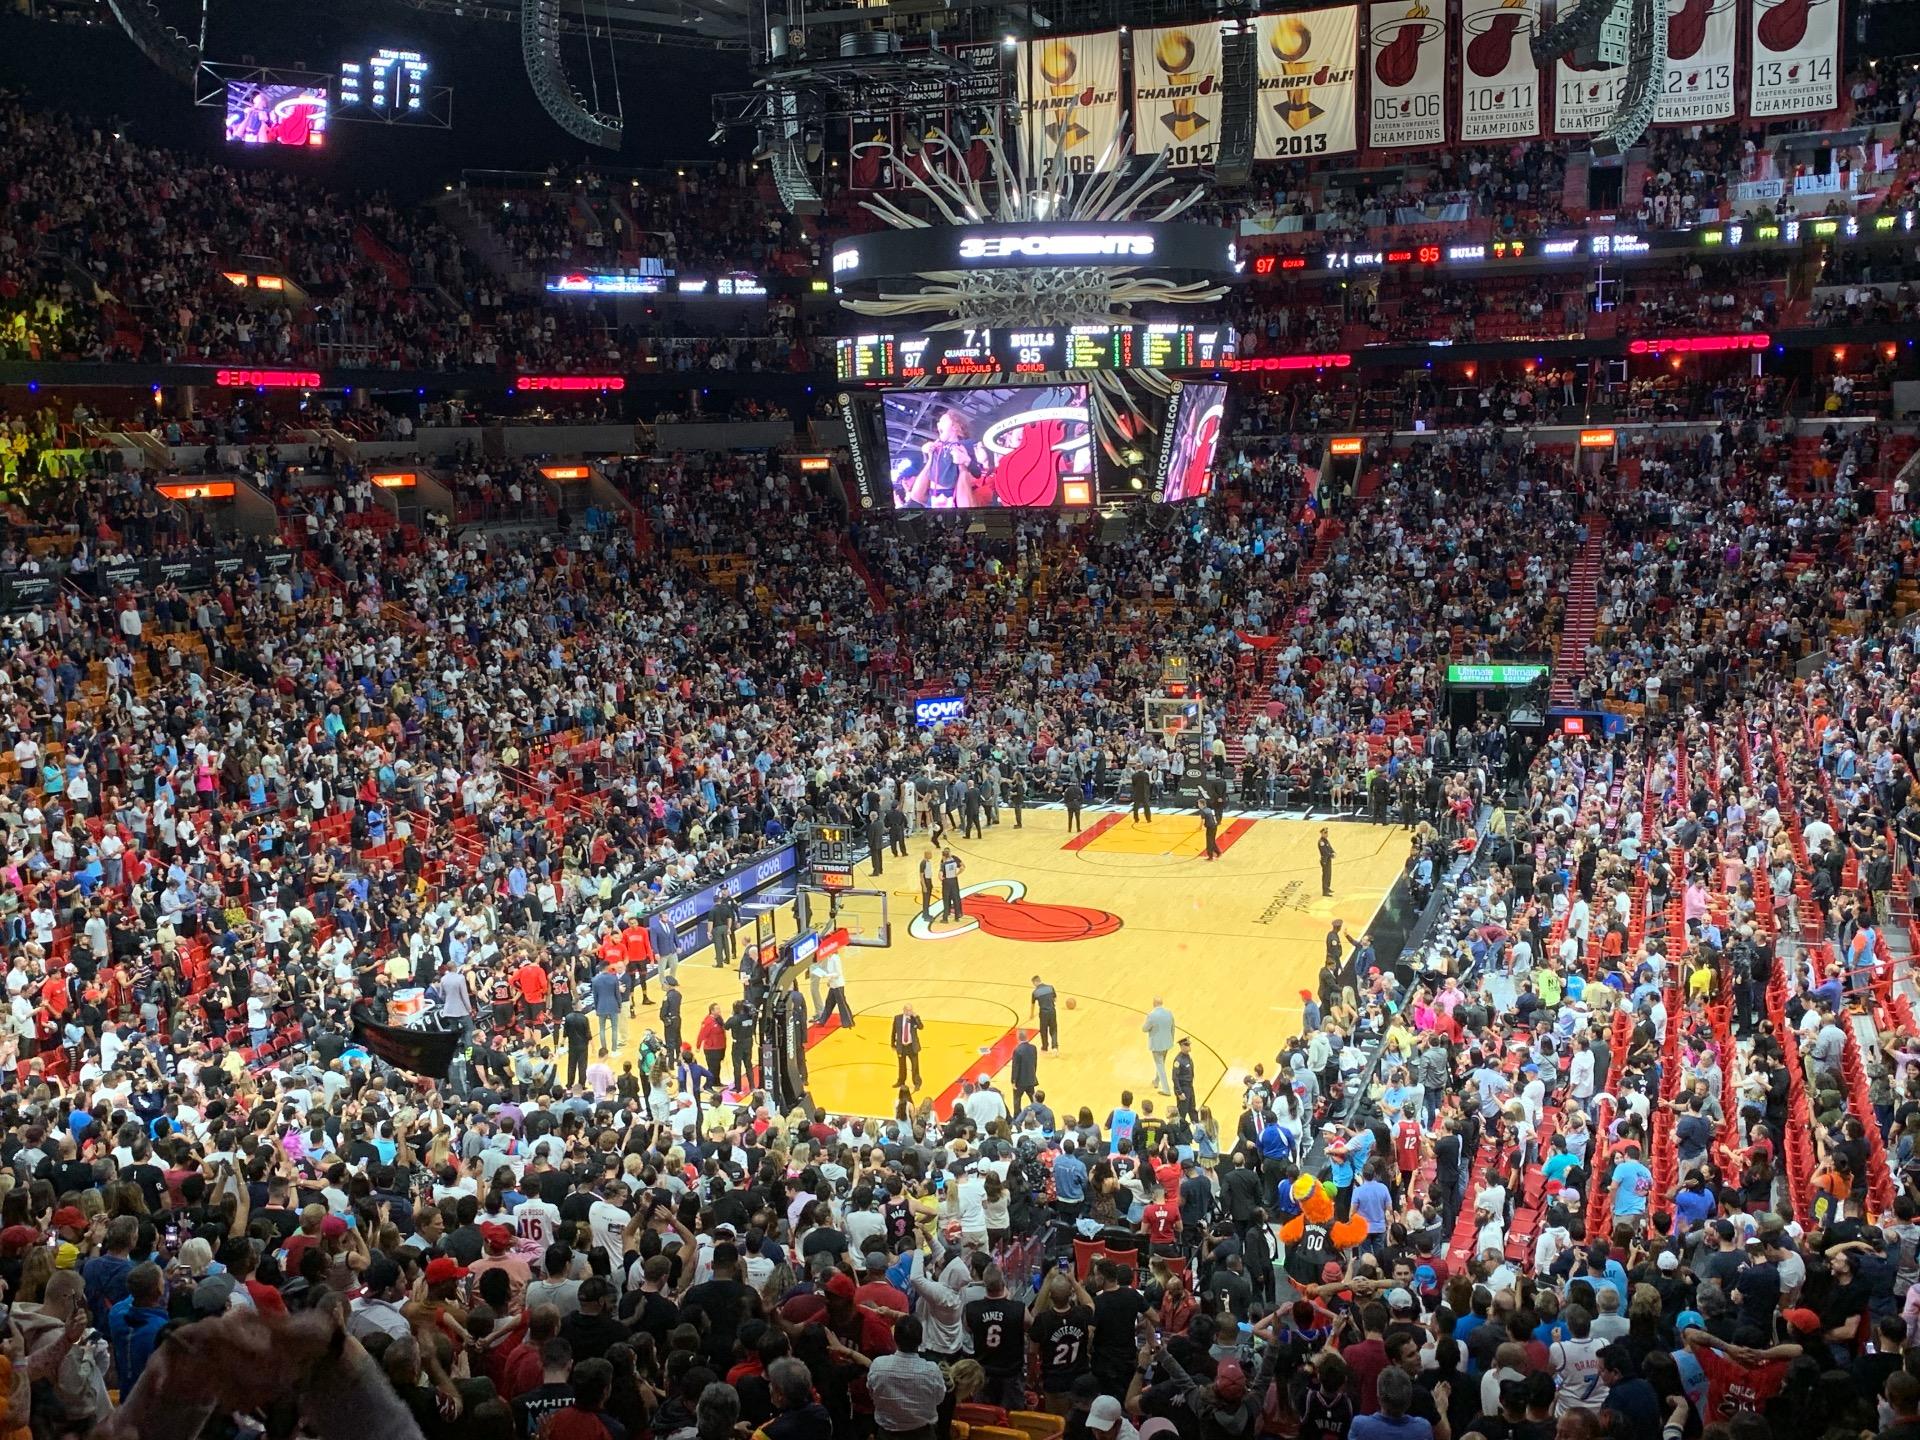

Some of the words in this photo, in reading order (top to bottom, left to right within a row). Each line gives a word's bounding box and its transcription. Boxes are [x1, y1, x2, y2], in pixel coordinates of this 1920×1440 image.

[379, 50, 399, 59] TEAM
[399, 52, 421, 61] STATS
[410, 70, 421, 80] 32
[1704, 65, 1729, 90] 13
[1757, 63, 1782, 87] 13
[1806, 58, 1832, 82] 14
[342, 78, 358, 87] FGA
[409, 83, 420, 94] 71
[1561, 82, 1583, 104] 11
[1468, 89, 1493, 112] 10
[1511, 85, 1532, 109] 11
[1754, 94, 1833, 112] CHAMPIONS
[1374, 98, 1399, 120] 05
[1414, 94, 1440, 117] 06
[1657, 102, 1730, 118] CHAMPIONS
[1373, 128, 1440, 143] CHAMPIONS
[1465, 120, 1534, 135] CHAMPIONS
[1276, 134, 1327, 156] 2013
[1166, 144, 1213, 166] 2012
[1614, 235, 1637, 244] Butler
[1705, 232, 1723, 244] MIN
[1759, 227, 1779, 238] PTS
[1593, 244, 1609, 252] #13
[1614, 243, 1649, 252] Adebayo
[1326, 253, 1350, 268] 7.1
[1354, 255, 1374, 264] QTR
[1374, 253, 1383, 263] 4
[1419, 247, 1439, 263] 95
[1450, 246, 1485, 259] BULLS
[1257, 258, 1274, 273] 97
[735, 286, 767, 295] Adebayo
[1070, 325, 1110, 335] CHICAGO
[963, 329, 990, 348] 7.1
[1010, 333, 1055, 348] BULLS
[905, 352, 922, 368] 97
[944, 350, 980, 358] QUARTER
[984, 348, 990, 356] 4
[1020, 348, 1041, 364] 95
[1201, 345, 1214, 360] 97
[945, 366, 966, 374] TEAM
[967, 364, 991, 373] FOULS
[960, 357, 975, 365] TOL
[1016, 363, 1045, 373] BONUS
[902, 368, 925, 377] BONUS
[842, 405, 869, 495] MICCOSUKEE.COM
[1155, 394, 1180, 491] MICCOSUKEE.COM
[106, 568, 140, 576] AmericanAirlines
[1457, 665, 1494, 676] Ultimate
[1502, 665, 1539, 676] Ultimate
[916, 700, 964, 720] GOYA
[757, 858, 780, 881] GOYA
[670, 900, 695, 925] GOYA
[1404, 1136, 1417, 1149] 12
[890, 1209, 907, 1219] WADE
[521, 1217, 543, 1241] 16
[894, 1218, 906, 1237] 3
[1305, 1224, 1328, 1237] BURNIE
[1307, 1234, 1324, 1251] 00
[982, 1311, 1004, 1323] JAMES
[986, 1325, 1002, 1348] 6
[1050, 1324, 1084, 1343] WHITESIDE
[1053, 1342, 1080, 1365] 21
[1580, 1373, 1600, 1400] 7
[1315, 1418, 1344, 1433] WADE
